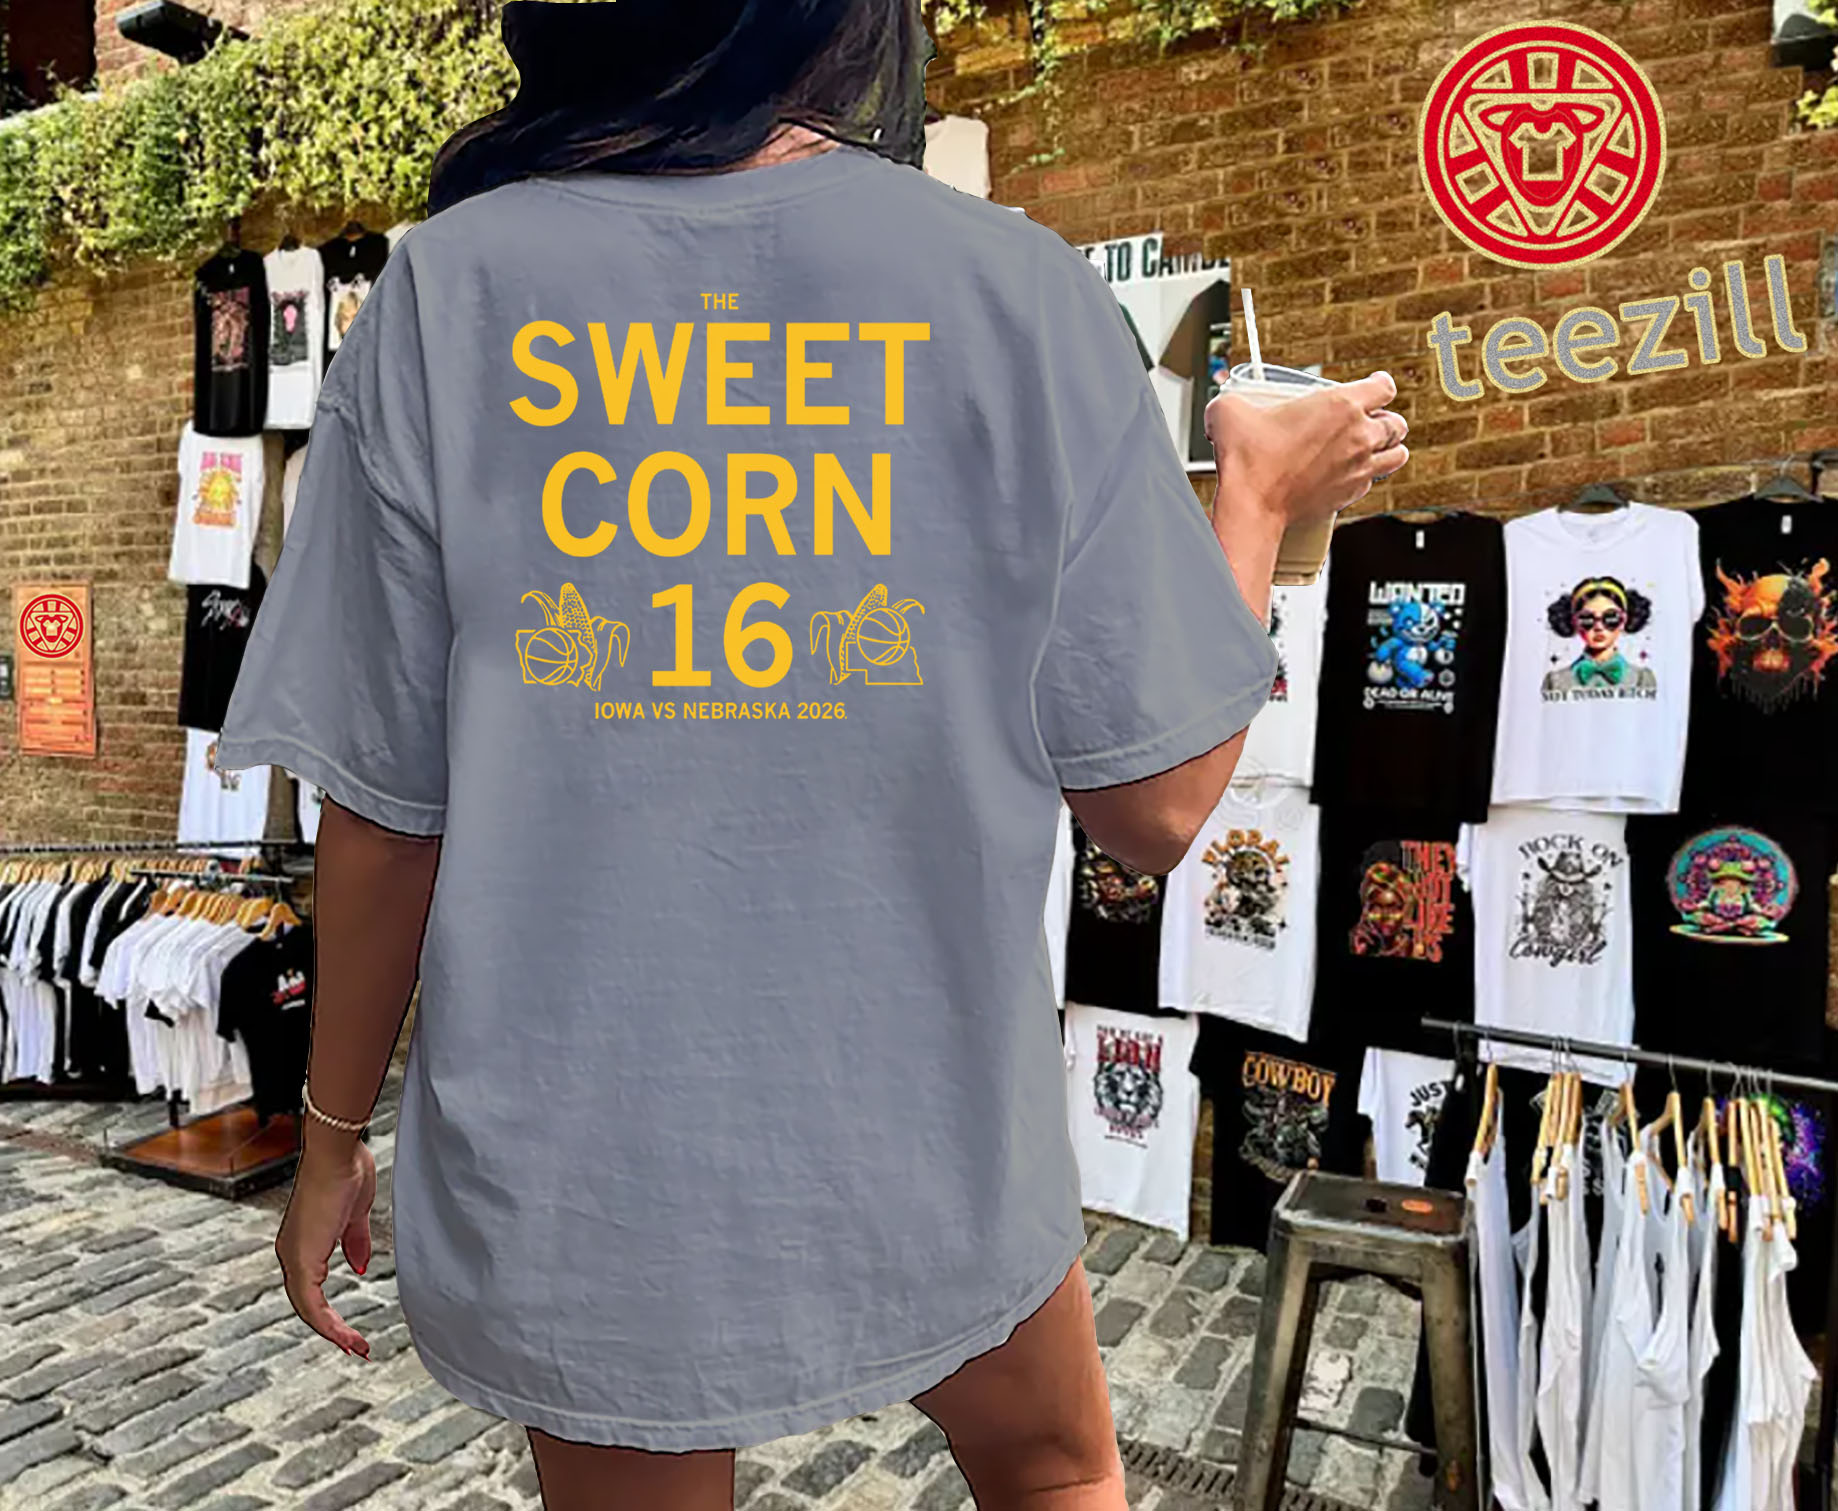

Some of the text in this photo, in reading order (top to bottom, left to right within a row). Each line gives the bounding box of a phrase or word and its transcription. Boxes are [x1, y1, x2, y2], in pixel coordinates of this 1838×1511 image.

[1105, 241, 1132, 282] TO
[700, 292, 740, 310] THE
[509, 320, 931, 427] SWEET
[541, 450, 892, 558] CORN
[1368, 581, 1466, 605] WANTED
[651, 581, 794, 689] 16
[594, 701, 646, 720] IOWA
[651, 701, 676, 720] VS
[683, 701, 791, 720] NEBRASKA
[1242, 1052, 1336, 1108] COWBOY
